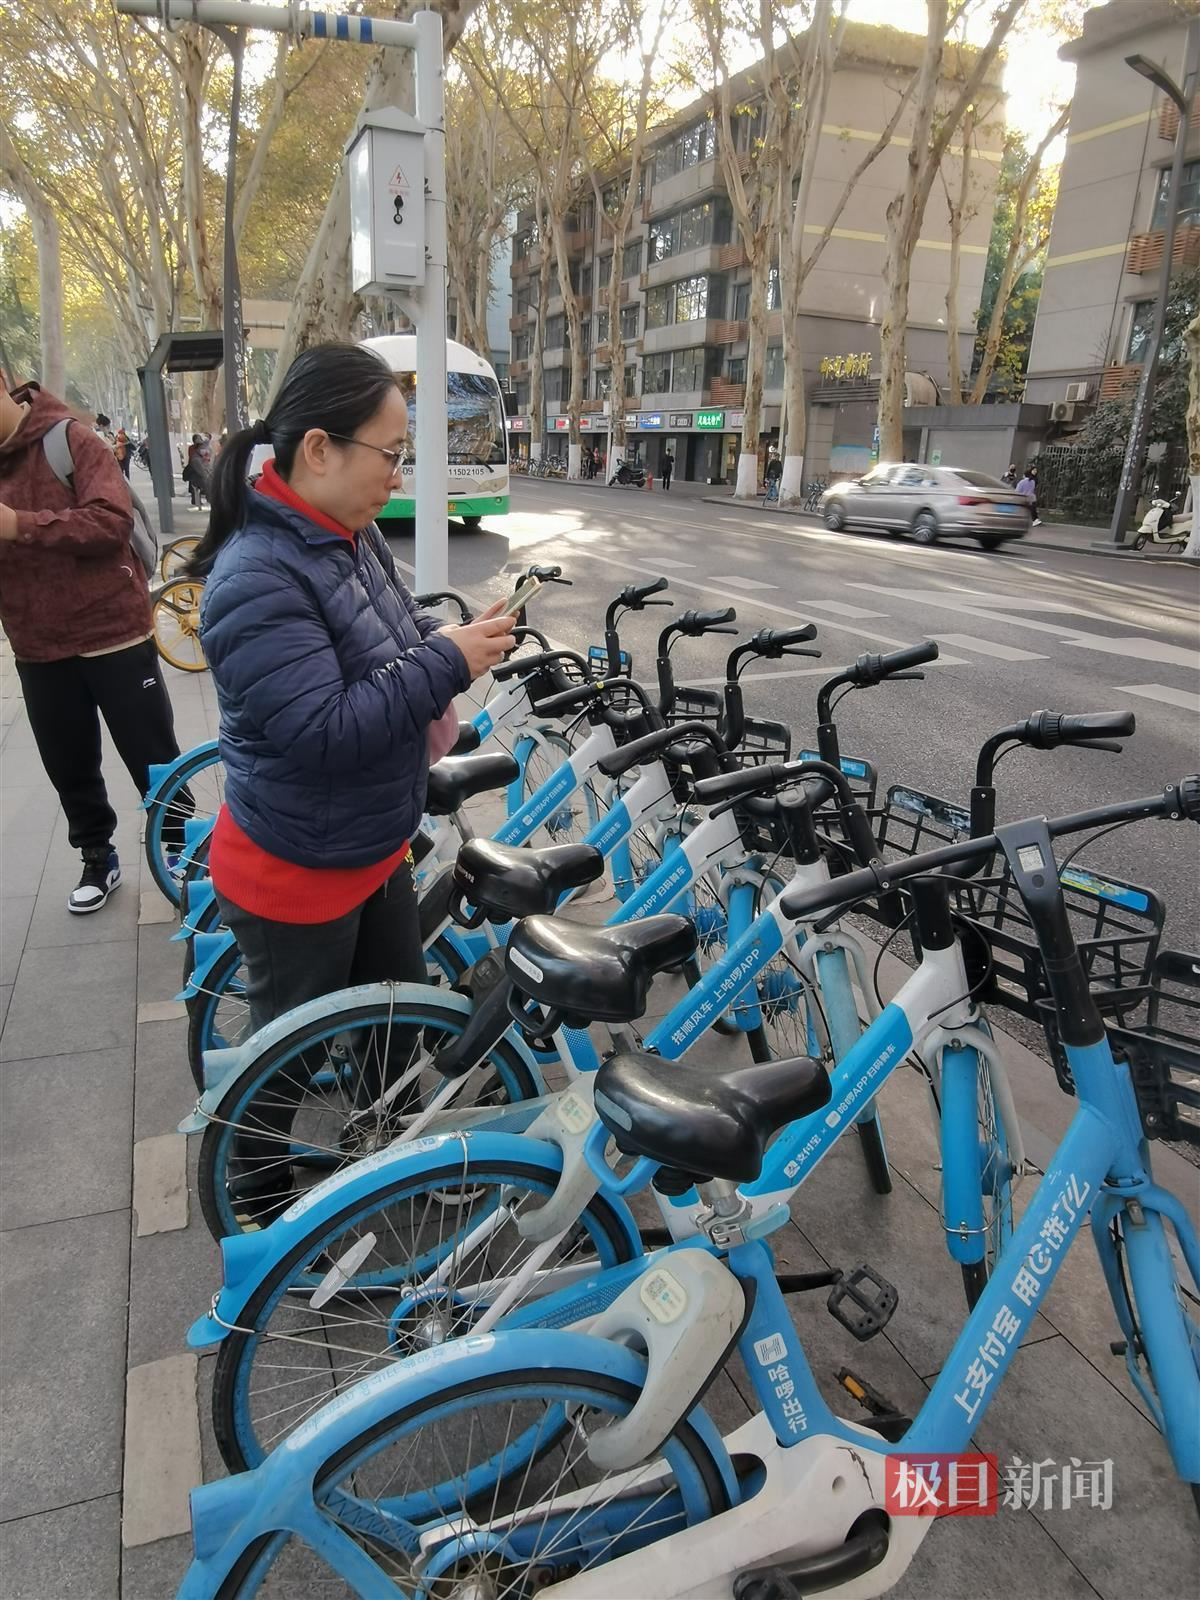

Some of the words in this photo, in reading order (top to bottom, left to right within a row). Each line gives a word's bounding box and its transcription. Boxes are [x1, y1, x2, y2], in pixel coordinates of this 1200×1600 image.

[656, 865, 687, 897] 扫码骑车
[671, 999, 714, 1046] 搭顺风车
[713, 948, 760, 1004] 上哈啰APP
[795, 1135, 822, 1166] 支付宝
[837, 1075, 870, 1115] 哈啰APP
[866, 1043, 897, 1080] 扫码骑车
[767, 1363, 808, 1434] 哈啰出行
[953, 1304, 1022, 1424] 上支付宝
